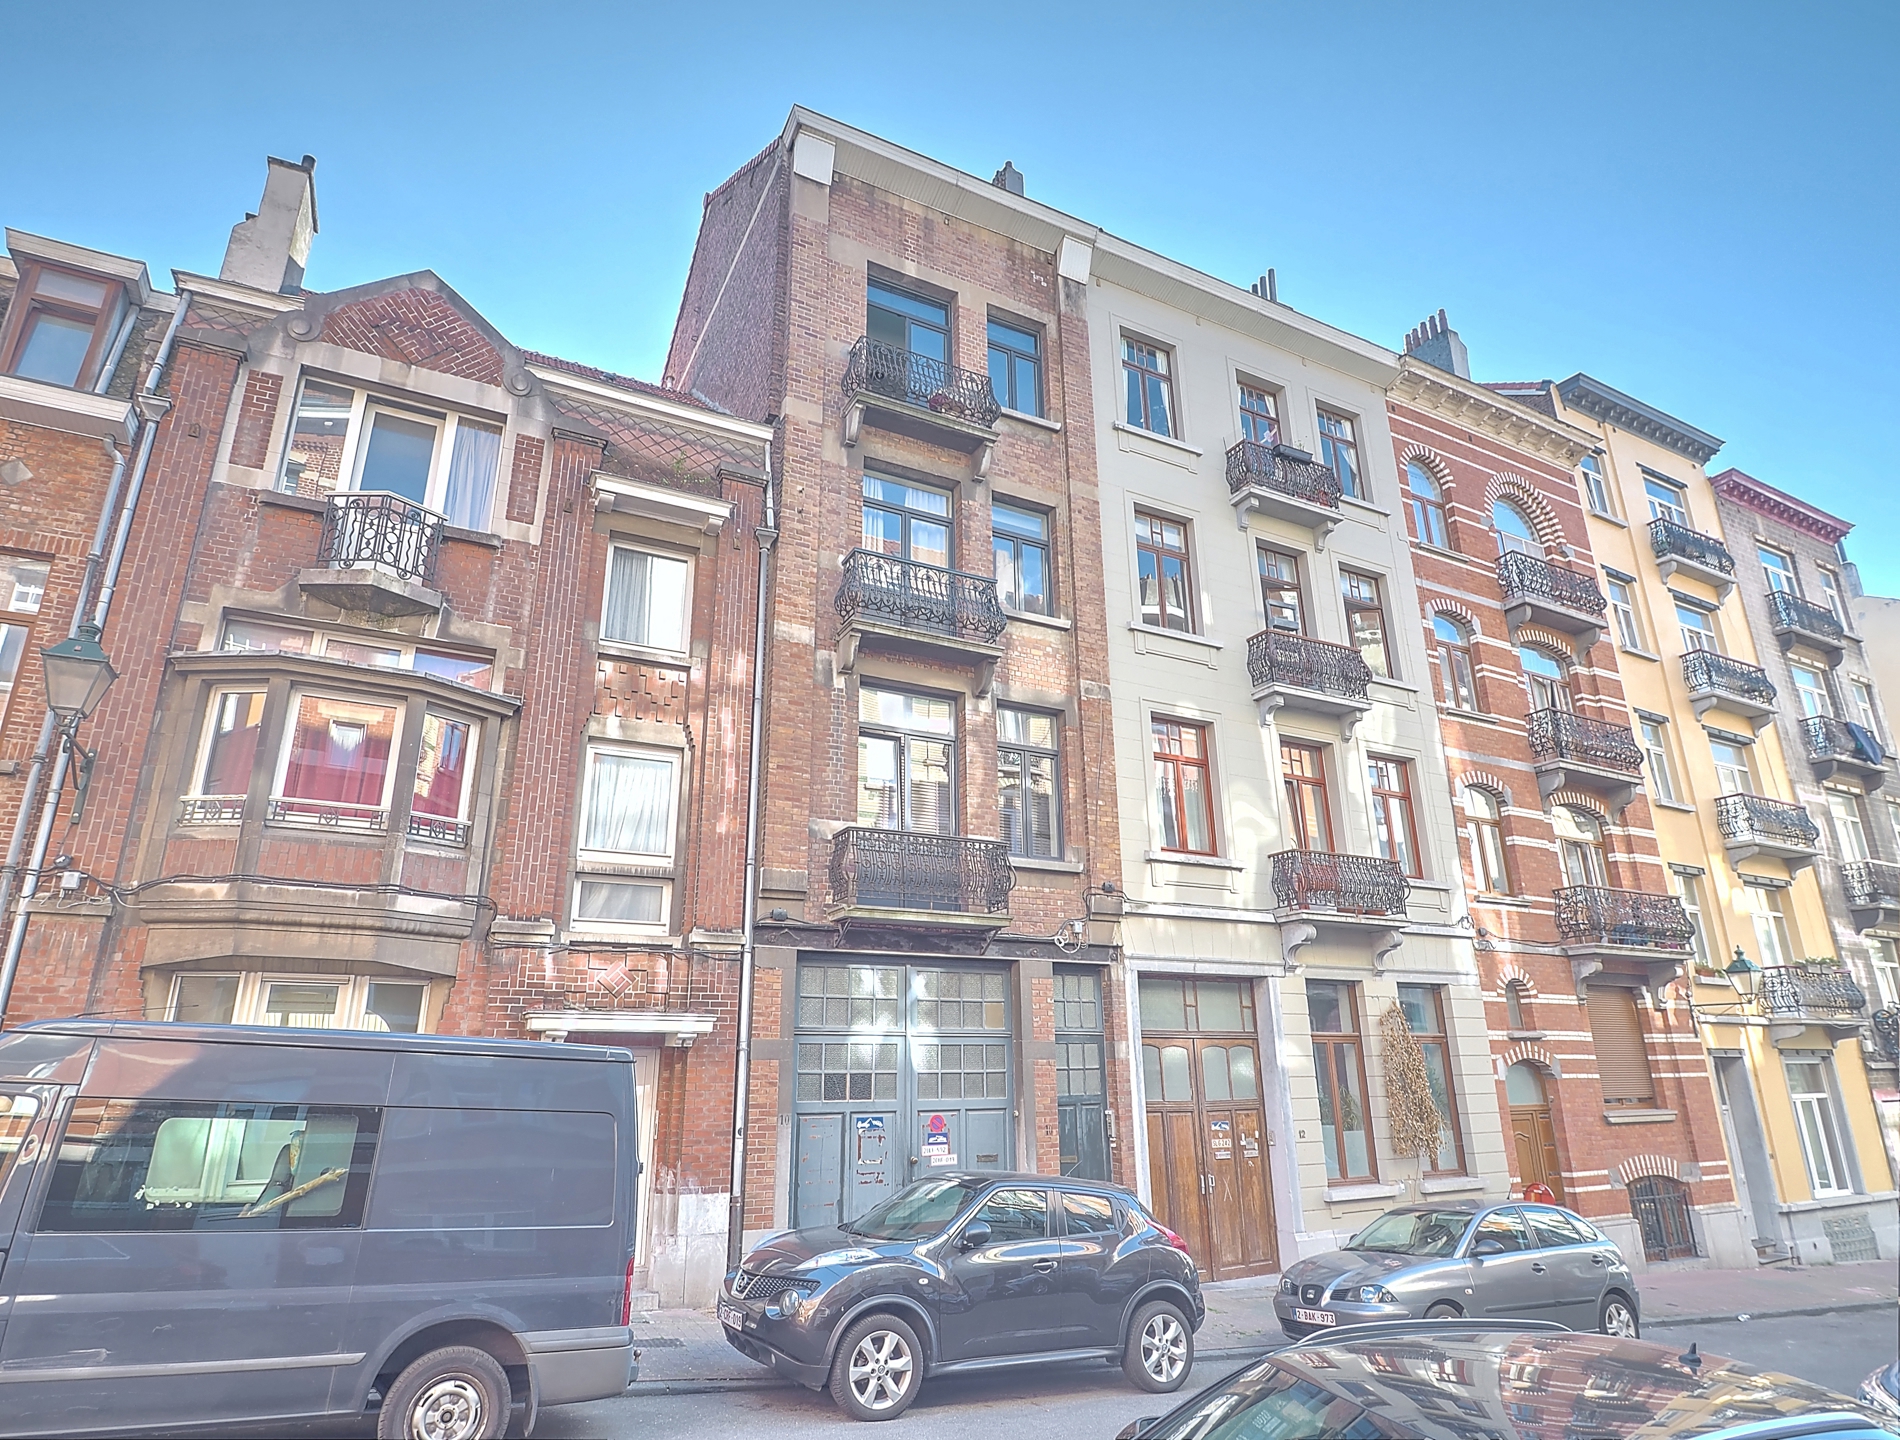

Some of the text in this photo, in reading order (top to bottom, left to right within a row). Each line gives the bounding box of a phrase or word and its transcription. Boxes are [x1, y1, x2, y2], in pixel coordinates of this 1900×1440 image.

[779, 1113, 791, 1126] 10
[1298, 1129, 1307, 1139] 12
[1297, 1310, 1334, 1324] 2-BAK-973
